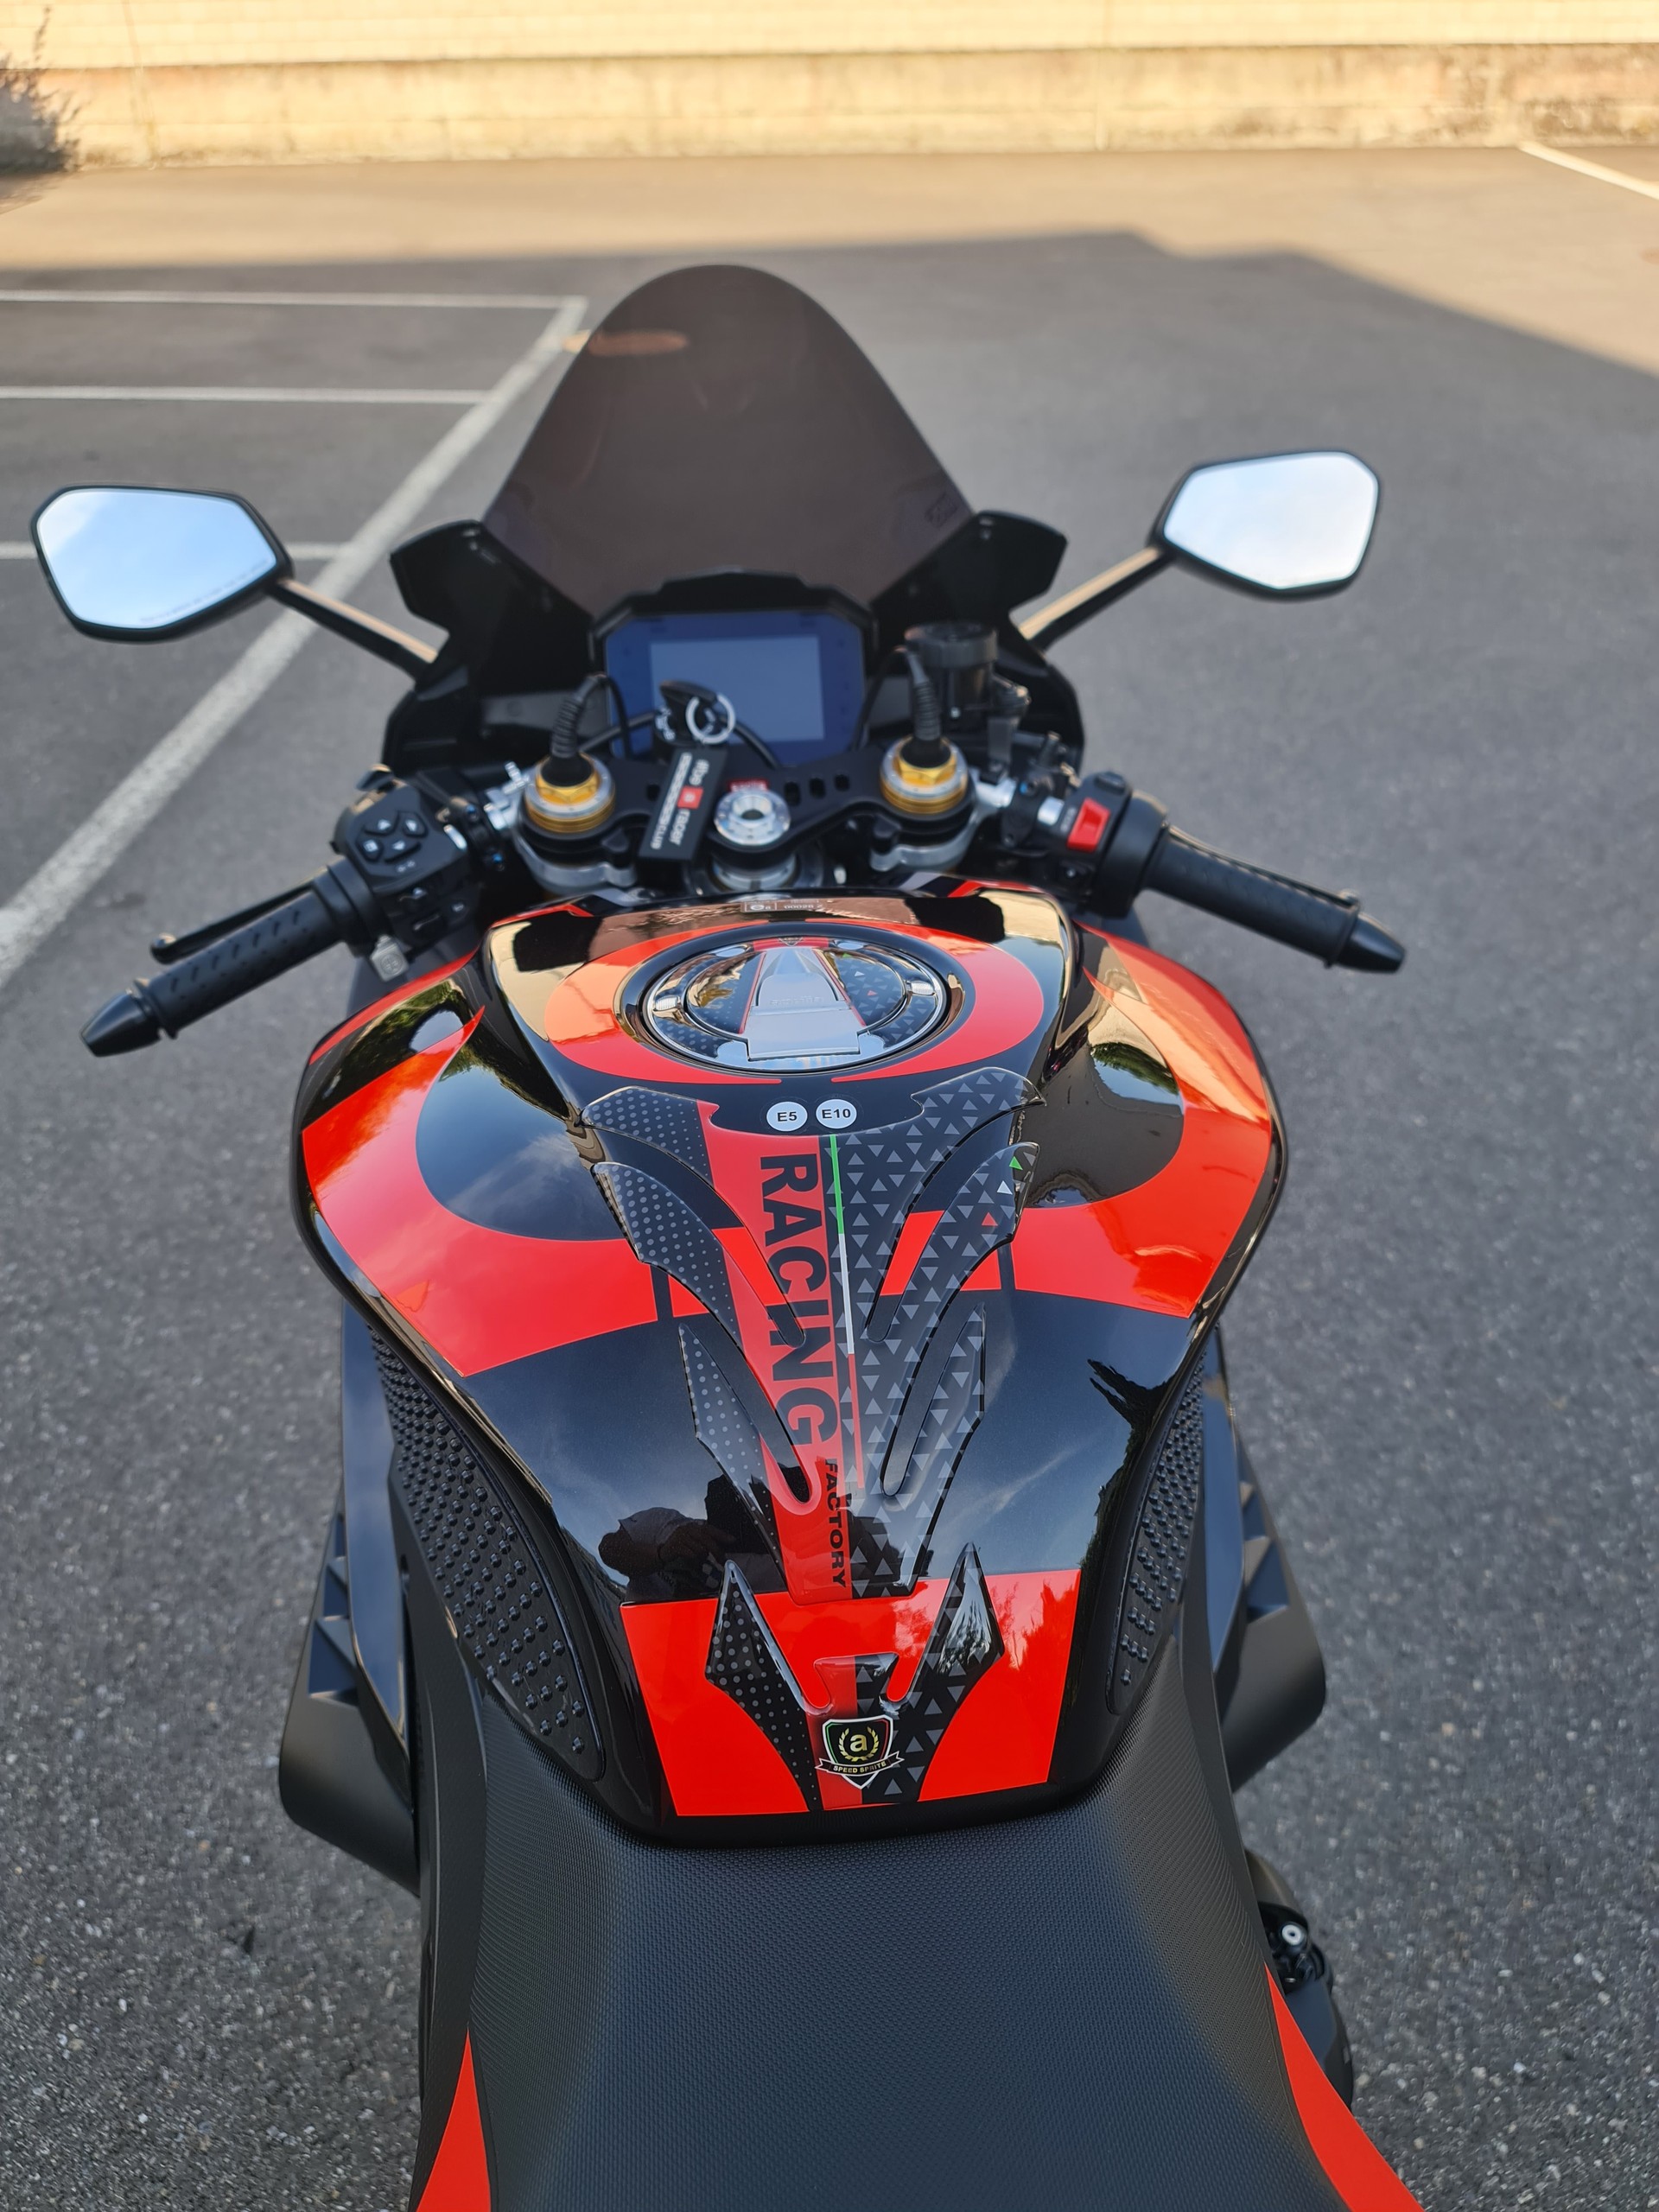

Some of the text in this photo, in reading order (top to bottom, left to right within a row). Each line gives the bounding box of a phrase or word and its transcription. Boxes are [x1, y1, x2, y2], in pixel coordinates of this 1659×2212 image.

[670, 809, 690, 846] racer
[777, 1109, 851, 1122] E5 E10
[760, 1154, 840, 1446] RACING
[825, 1458, 846, 1588] FACTORY
[849, 1733, 868, 1752] a
